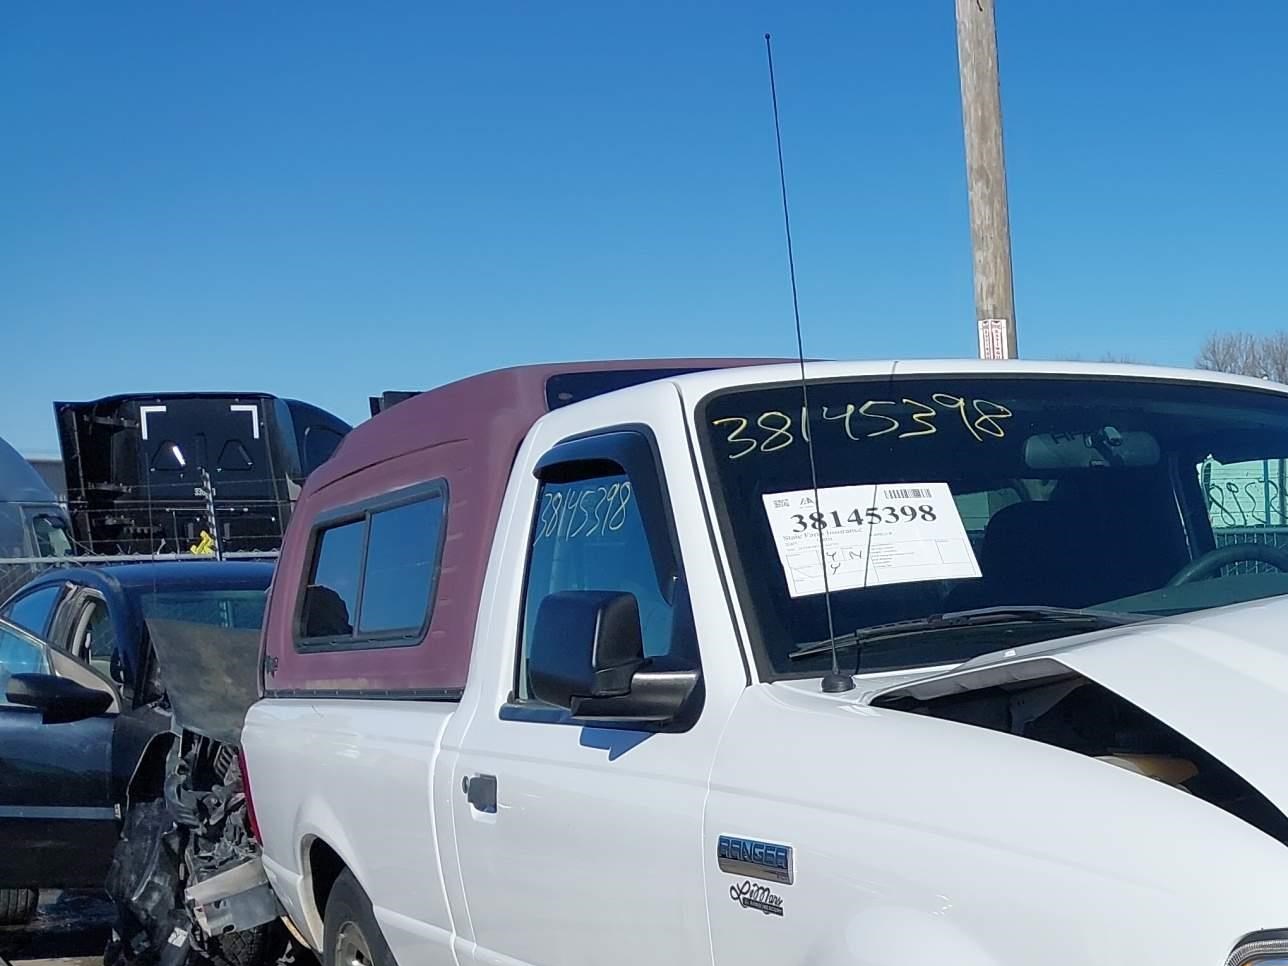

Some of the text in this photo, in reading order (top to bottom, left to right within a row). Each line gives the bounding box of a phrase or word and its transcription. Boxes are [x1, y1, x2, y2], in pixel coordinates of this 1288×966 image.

[712, 393, 1013, 459] 38145398
[533, 481, 631, 546] 38145398
[790, 504, 938, 533] 38145398
[718, 837, 788, 869] RANGER
